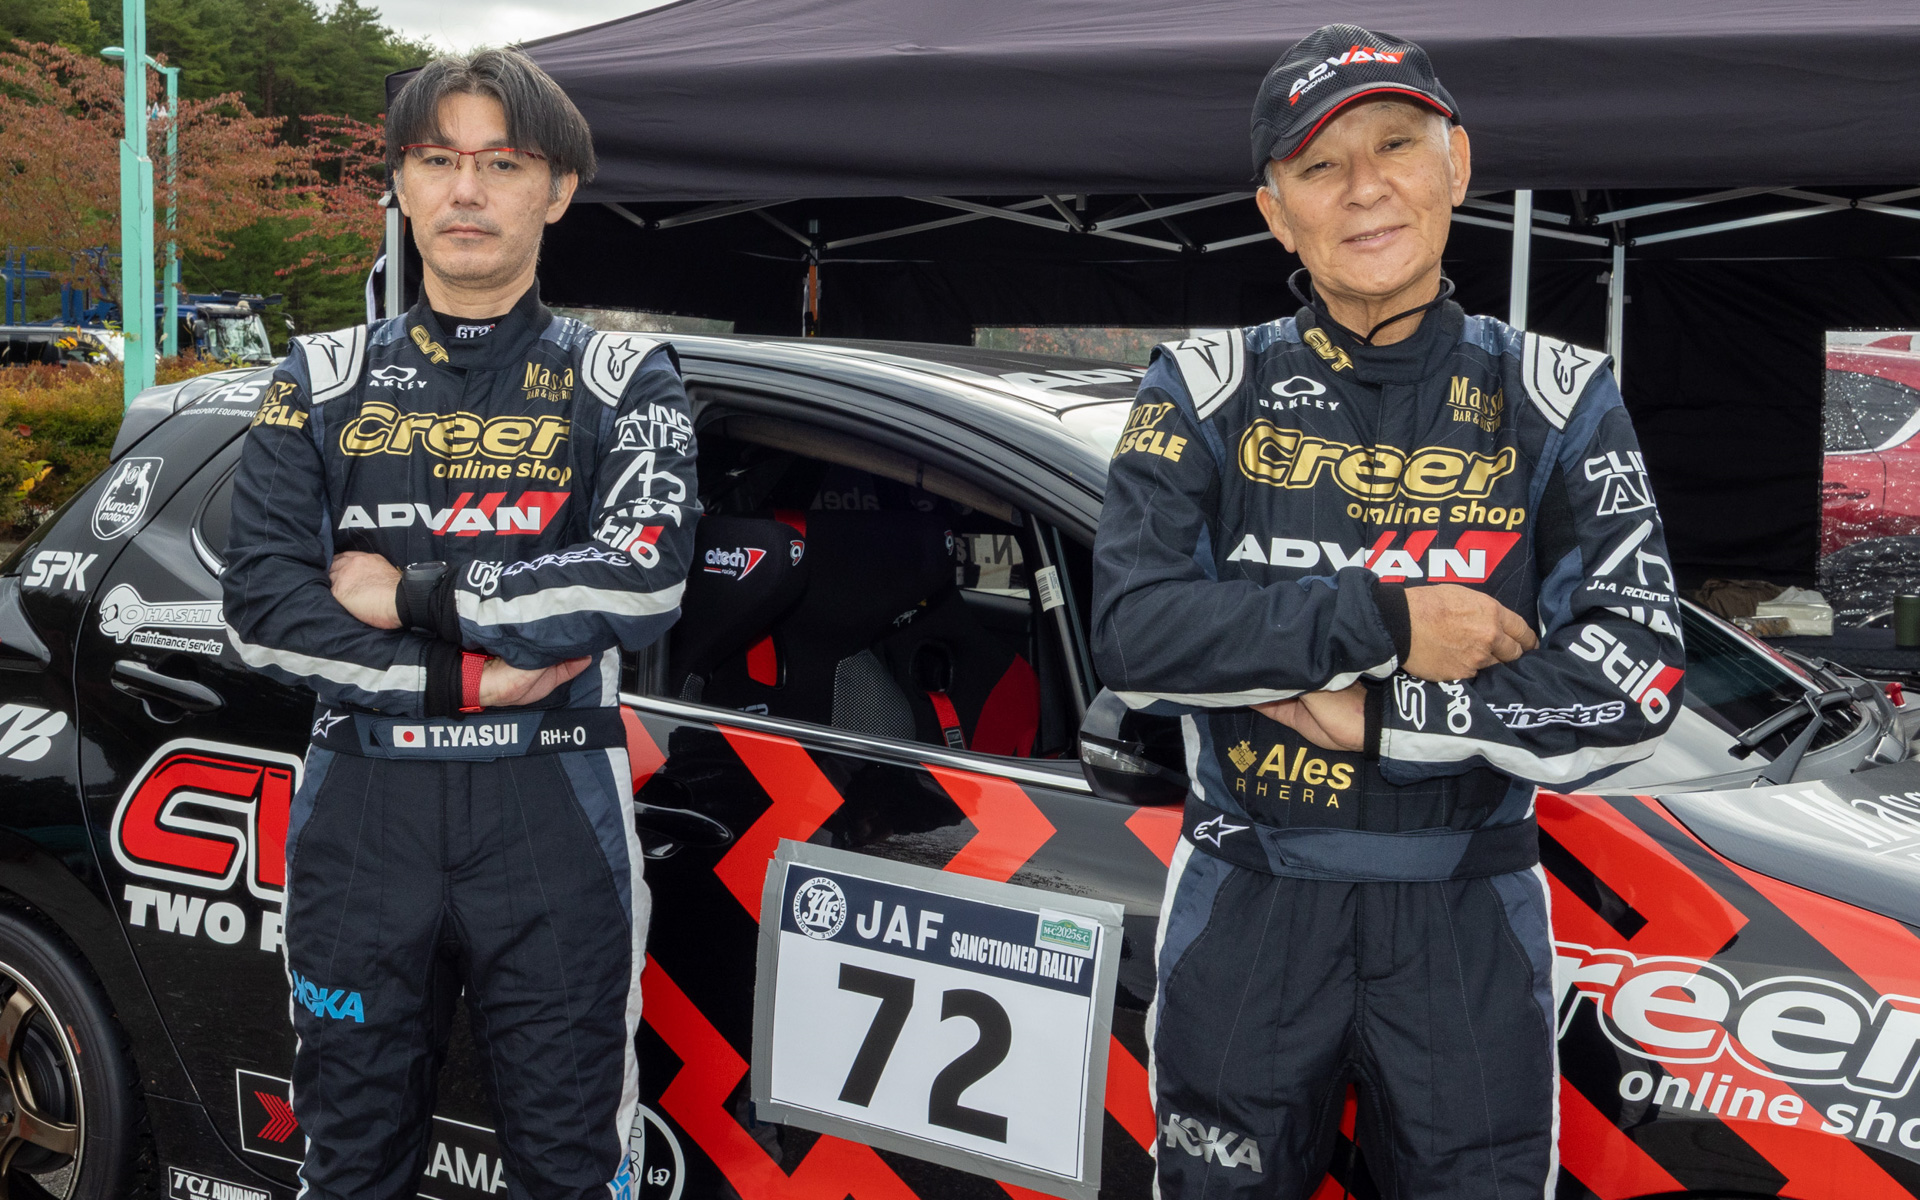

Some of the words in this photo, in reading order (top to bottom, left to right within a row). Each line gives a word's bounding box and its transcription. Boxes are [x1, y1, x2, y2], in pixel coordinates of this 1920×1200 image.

[1288, 49, 1401, 99] ADVAN
[1258, 396, 1340, 411] OAKLEY
[1453, 409, 1471, 422] BAR
[1473, 412, 1480, 424] &
[340, 401, 571, 459] Creer
[433, 460, 512, 479] online
[516, 460, 572, 487] shop
[1239, 418, 1517, 502] Creer
[99, 511, 130, 524] motors
[101, 497, 139, 515] Kuroda
[338, 500, 550, 534] ADVAN
[1346, 502, 1440, 525] online
[1449, 500, 1526, 530] shop
[24, 550, 98, 591] SPK
[705, 546, 746, 568] atech
[1227, 533, 1496, 580] ADVAN
[119, 604, 212, 625] OHASHI
[133, 632, 186, 649] maintenance
[188, 640, 222, 654] service
[1568, 624, 1670, 724] Stilo
[429, 723, 518, 748] T.YASUI
[1256, 744, 1355, 790] Ales
[811, 878, 837, 890] JAPAN
[124, 884, 246, 945] TWO
[821, 897, 846, 939] AUTOMOBILE
[856, 900, 944, 951] JAF
[950, 931, 1039, 975] SANCTIONED
[1039, 950, 1085, 983] RALLY
[292, 970, 365, 1023] HOKA
[838, 963, 1012, 1144] 72
[1619, 1070, 1804, 1126] online
[1158, 1113, 1262, 1173] HOKA
[174, 1172, 210, 1197] TCL
[424, 1142, 509, 1195] AMA
